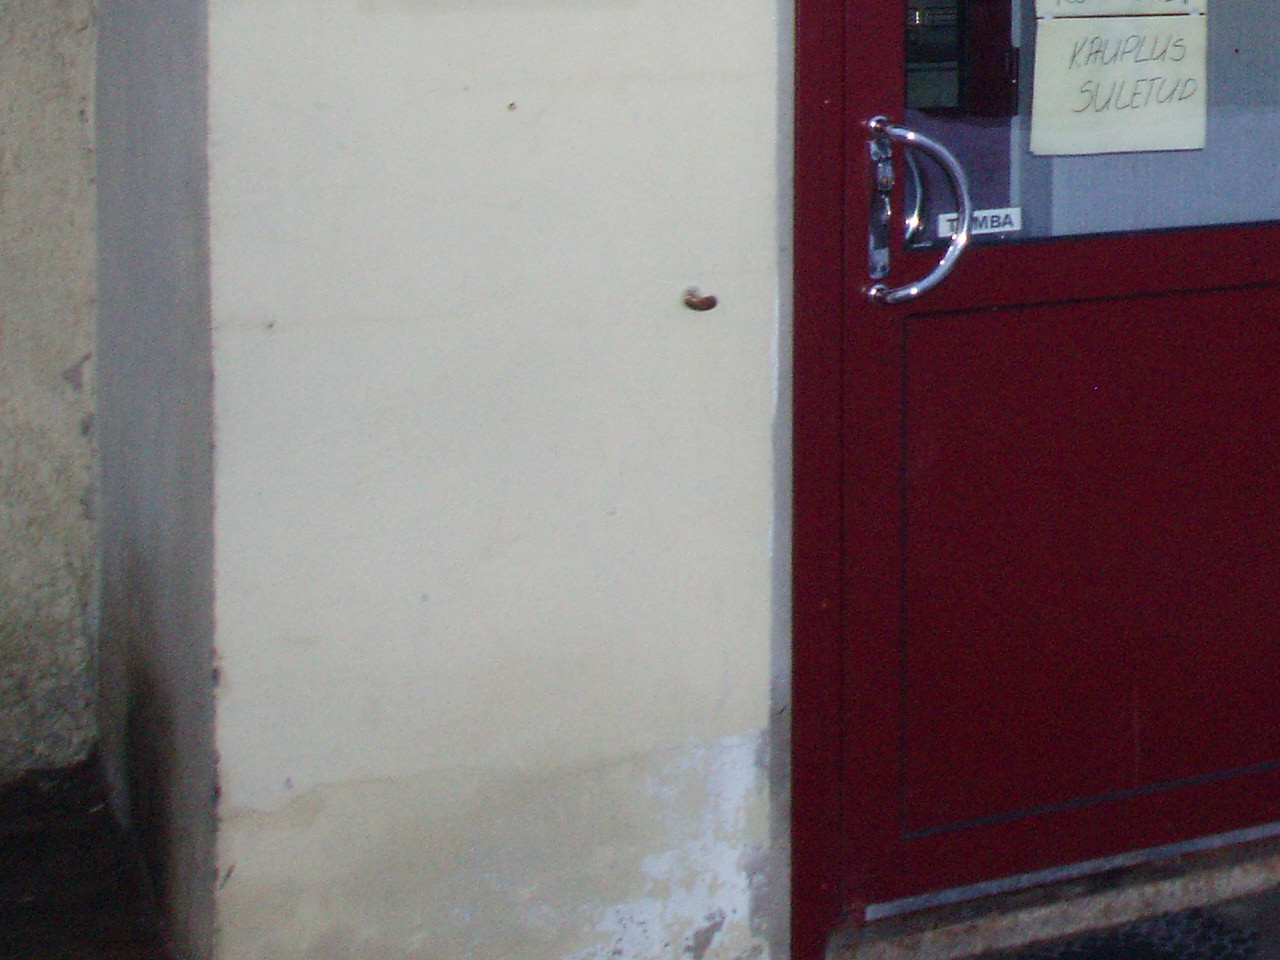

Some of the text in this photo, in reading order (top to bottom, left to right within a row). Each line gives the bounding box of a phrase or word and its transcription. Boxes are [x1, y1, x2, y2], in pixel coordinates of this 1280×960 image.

[1067, 34, 1187, 70] KAUPLUS
[1073, 76, 1199, 113] SULETUD
[946, 213, 1015, 233] TMBA
